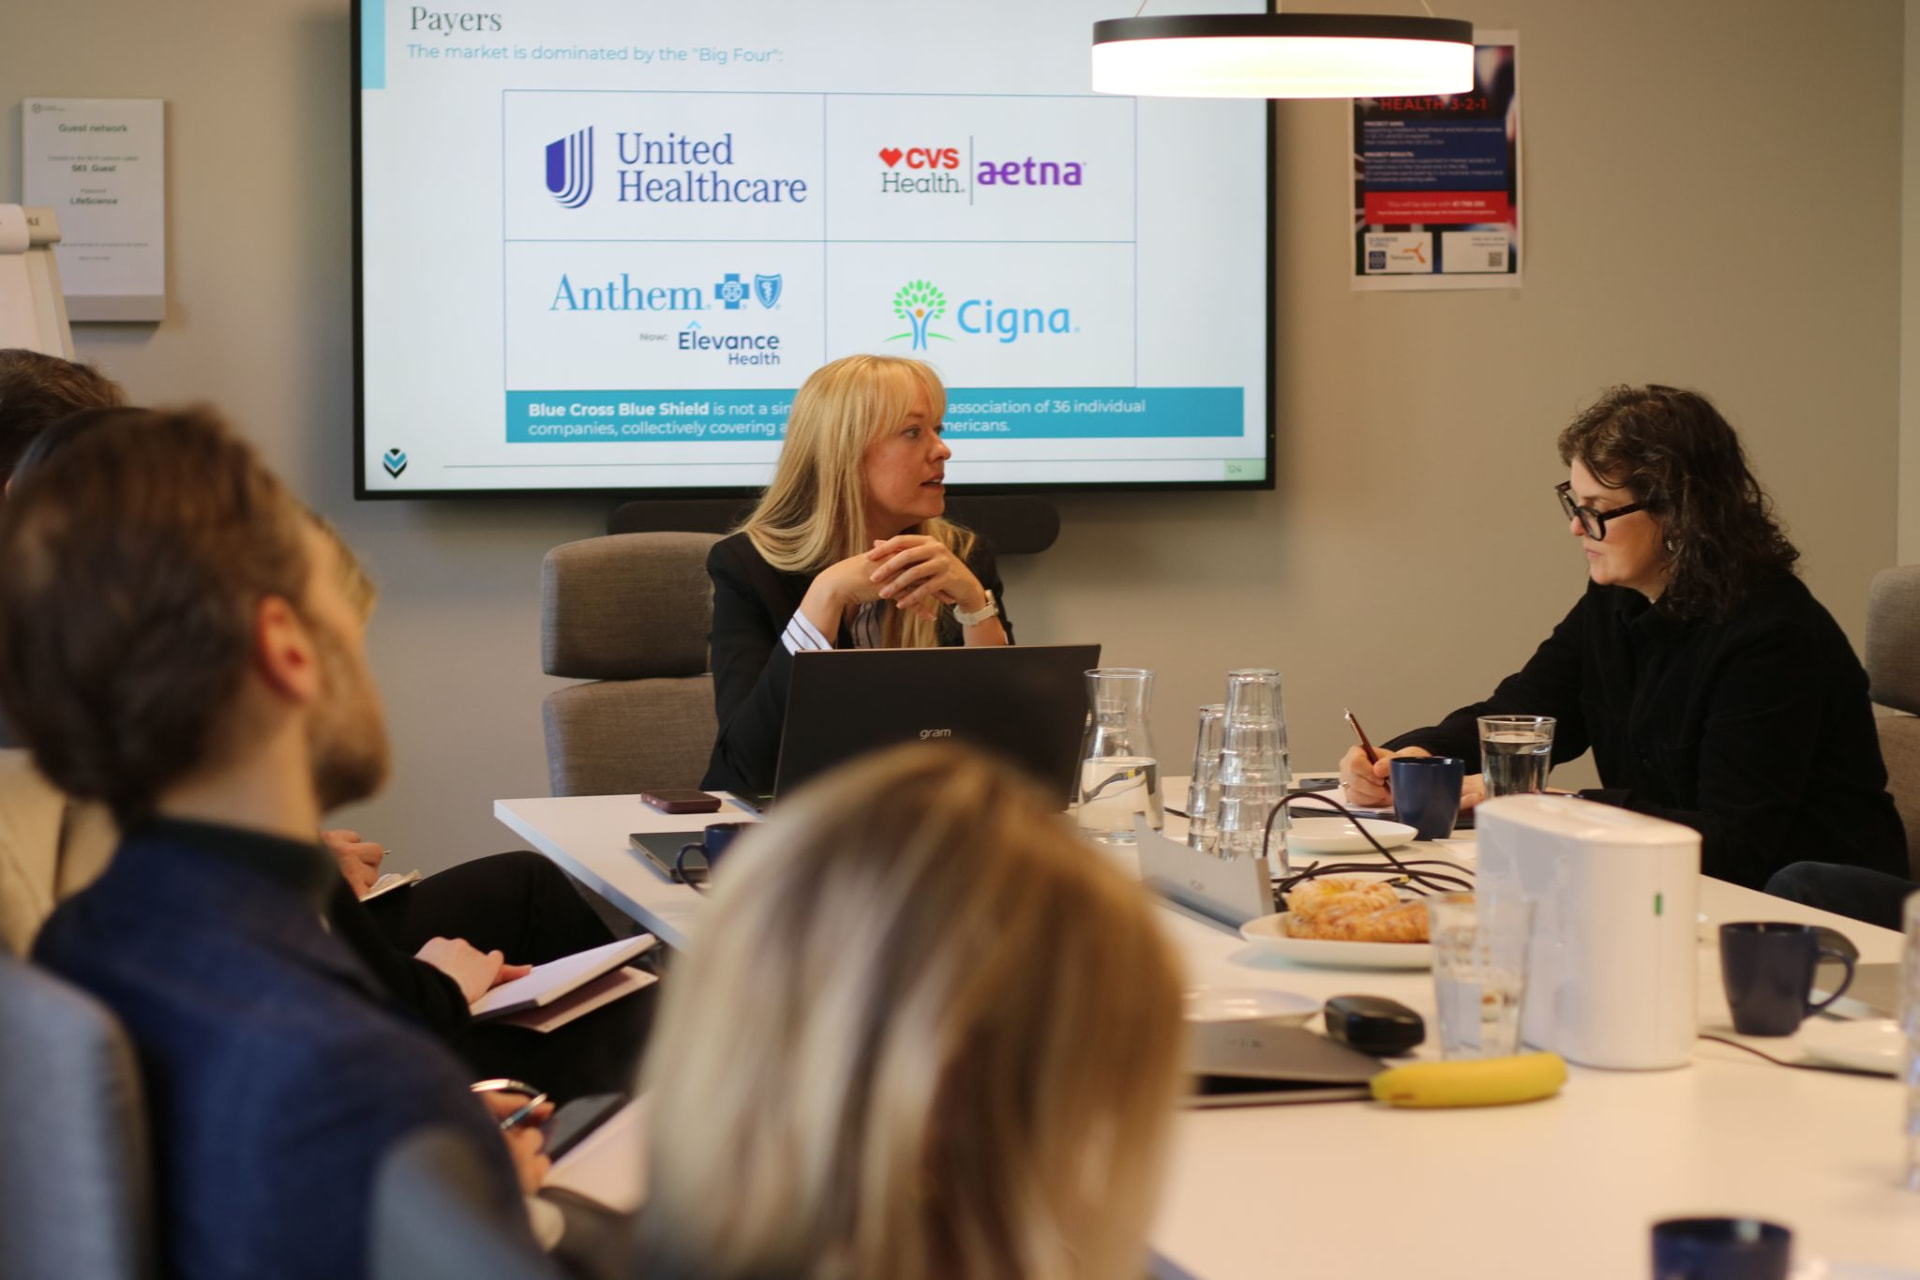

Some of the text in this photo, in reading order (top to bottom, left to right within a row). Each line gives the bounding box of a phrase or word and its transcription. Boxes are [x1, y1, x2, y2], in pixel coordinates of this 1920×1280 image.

[410, 5, 503, 36] Payers
[407, 44, 440, 59] The
[445, 45, 508, 60] market
[514, 45, 527, 60] is
[531, 45, 628, 61] dominated
[634, 47, 655, 64] by
[659, 47, 688, 61] the
[1380, 97, 1487, 111] HEALTH 3-2-1
[58, 123, 128, 133] Guest network
[616, 132, 734, 165] United
[905, 147, 960, 170] CVS
[977, 156, 1083, 186] aetna
[616, 169, 808, 203] Healthcare
[69, 197, 119, 206] LifeScience
[549, 272, 706, 311] Anthem
[957, 299, 1071, 343] Cigna
[678, 330, 780, 350] Elevance
[728, 352, 781, 366] Health
[529, 403, 566, 417] Blue
[570, 403, 615, 417] Cross
[618, 402, 656, 416] Blue
[659, 401, 710, 416] Shield
[713, 402, 726, 416] is
[729, 404, 755, 416] not
[758, 404, 768, 415] a
[948, 399, 1146, 414] association of 36 individual
[528, 421, 618, 437] companies,
[621, 420, 707, 437] collectively
[709, 420, 776, 436] covering
[942, 418, 1011, 432] mericans.
[919, 728, 952, 740] gram
